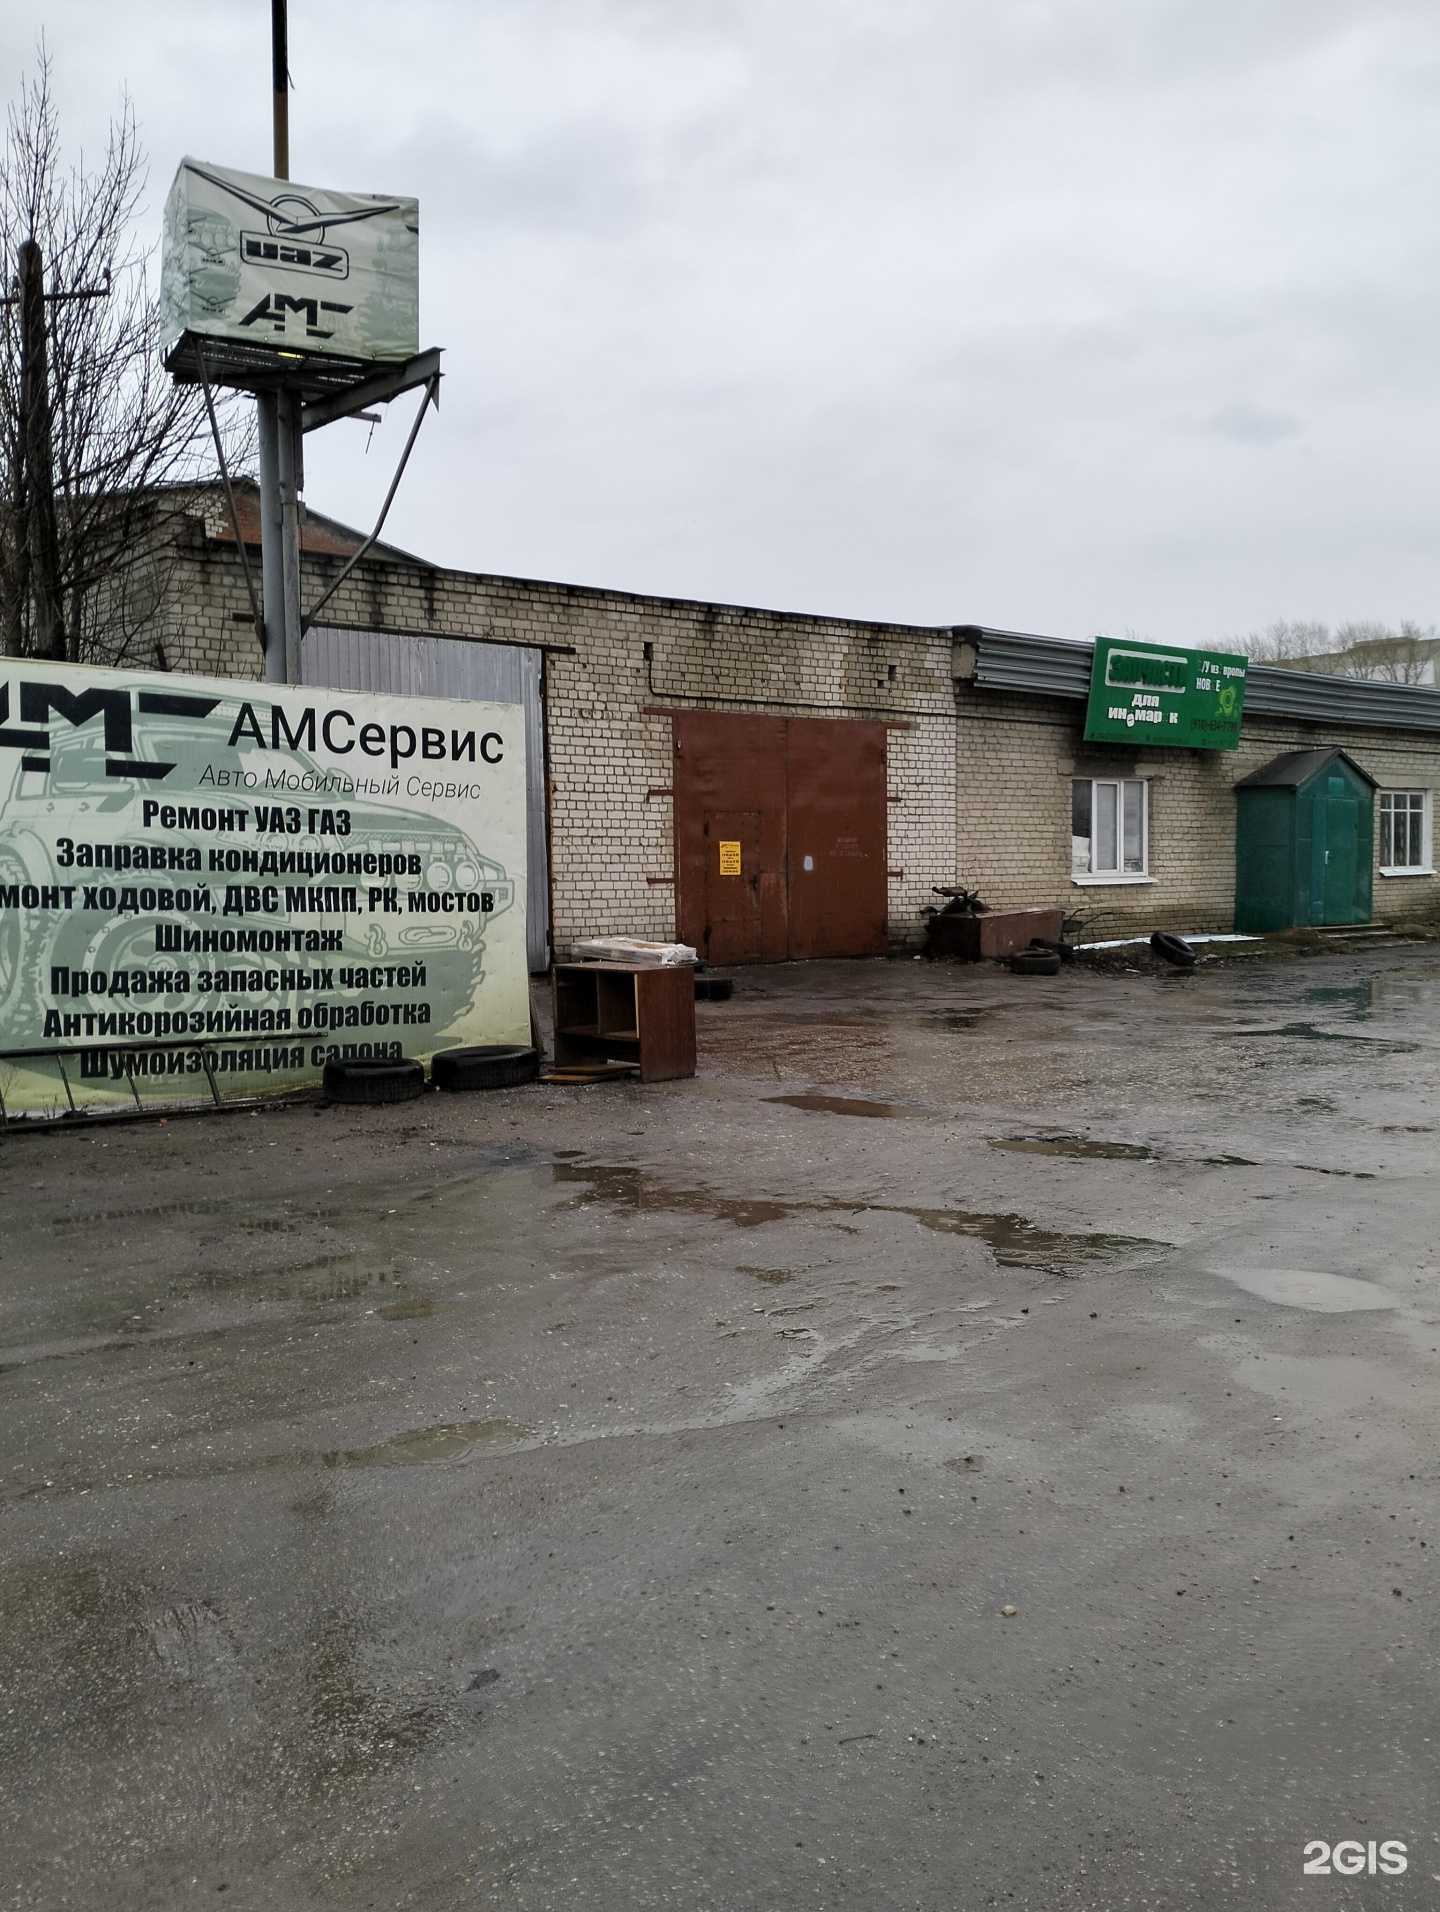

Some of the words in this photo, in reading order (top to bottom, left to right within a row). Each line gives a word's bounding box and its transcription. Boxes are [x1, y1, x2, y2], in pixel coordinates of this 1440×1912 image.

[228, 702, 504, 769] АМСервис
[199, 764, 257, 788] Авто
[264, 768, 400, 797] Мобильный
[406, 776, 481, 802] Сервис
[143, 799, 249, 832] Ремонт
[254, 805, 301, 833] УАЗ
[307, 808, 351, 836] ГАЗ
[56, 838, 201, 871] Заправка
[208, 849, 422, 877] кондиционеров
[83, 882, 217, 915] ходовой,
[223, 885, 279, 916] ДВС
[285, 886, 363, 915] МКПП,
[368, 887, 403, 915] РК,
[408, 891, 494, 913] мостов
[155, 924, 343, 953] Шиномонтаж
[51, 966, 190, 998] Продажа
[197, 967, 334, 993] запасных
[339, 960, 427, 988] частей
[43, 1004, 291, 1037] Антикорозийная
[297, 1000, 431, 1030] обработка
[79, 1044, 305, 1080] Шумоизоляция
